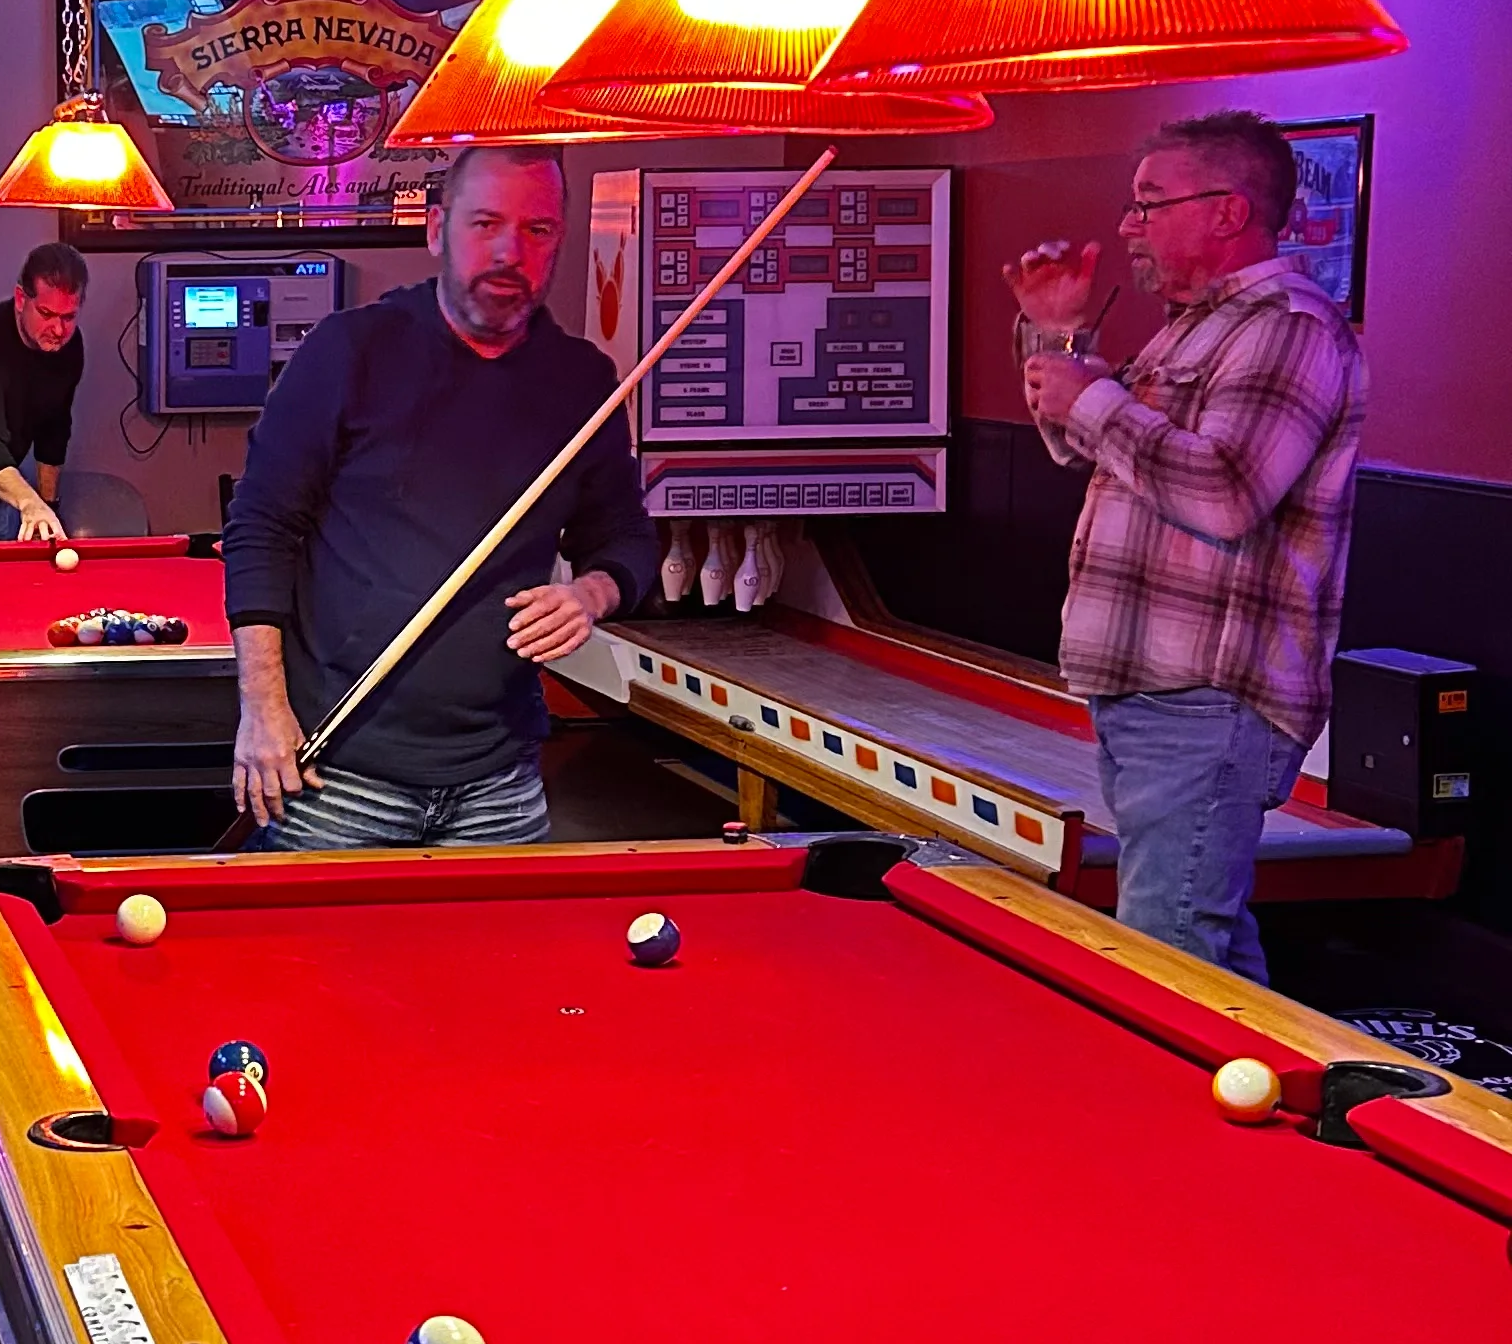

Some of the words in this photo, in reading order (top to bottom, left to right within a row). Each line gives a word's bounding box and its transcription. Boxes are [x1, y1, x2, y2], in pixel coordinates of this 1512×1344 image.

[191, 17, 306, 70] SIERRA
[313, 16, 437, 67] NEVADA
[179, 175, 286, 199] Traditional
[288, 172, 341, 198] Ales
[344, 176, 382, 194] and
[1294, 150, 1332, 204] BEAM
[295, 264, 326, 274] ATM
